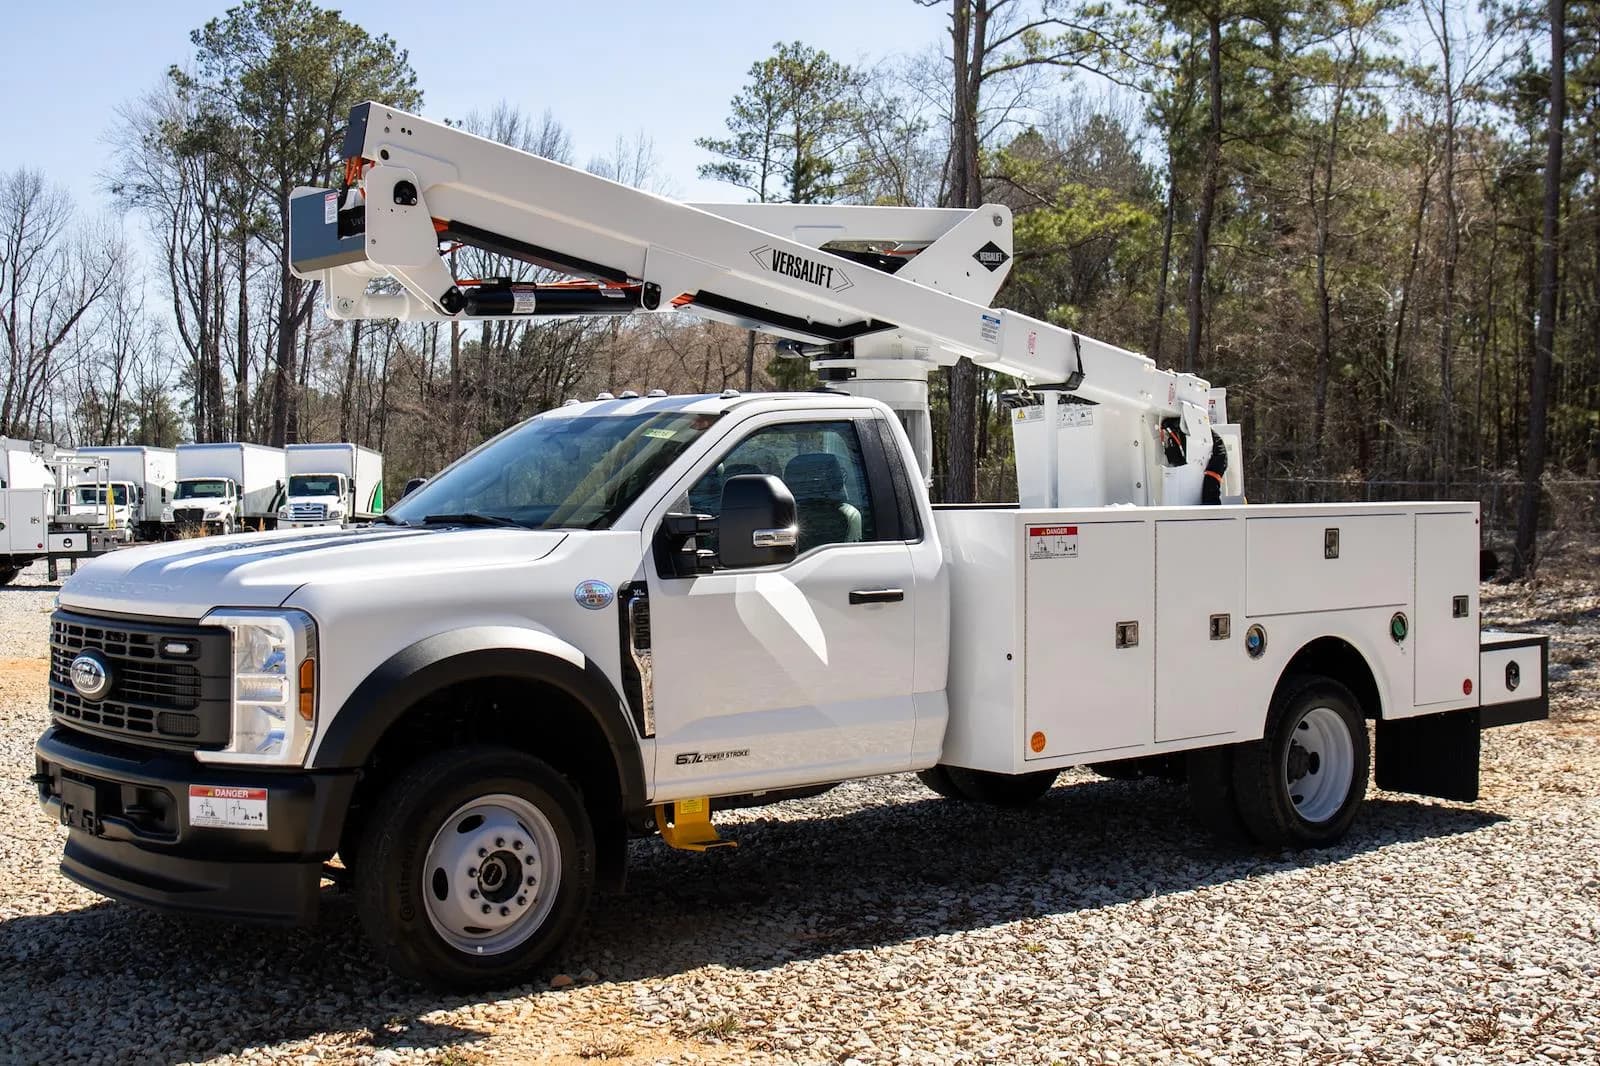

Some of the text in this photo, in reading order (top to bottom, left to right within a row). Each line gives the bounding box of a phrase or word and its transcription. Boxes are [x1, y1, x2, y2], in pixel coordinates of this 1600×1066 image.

[979, 251, 1002, 262] VERSALIFT
[772, 249, 834, 289] VERSALIFT
[1046, 527, 1068, 536] DANGER
[632, 588, 645, 596] XL
[676, 749, 749, 765] 6.7L POWER STROKE
[214, 788, 249, 798] DANGER
